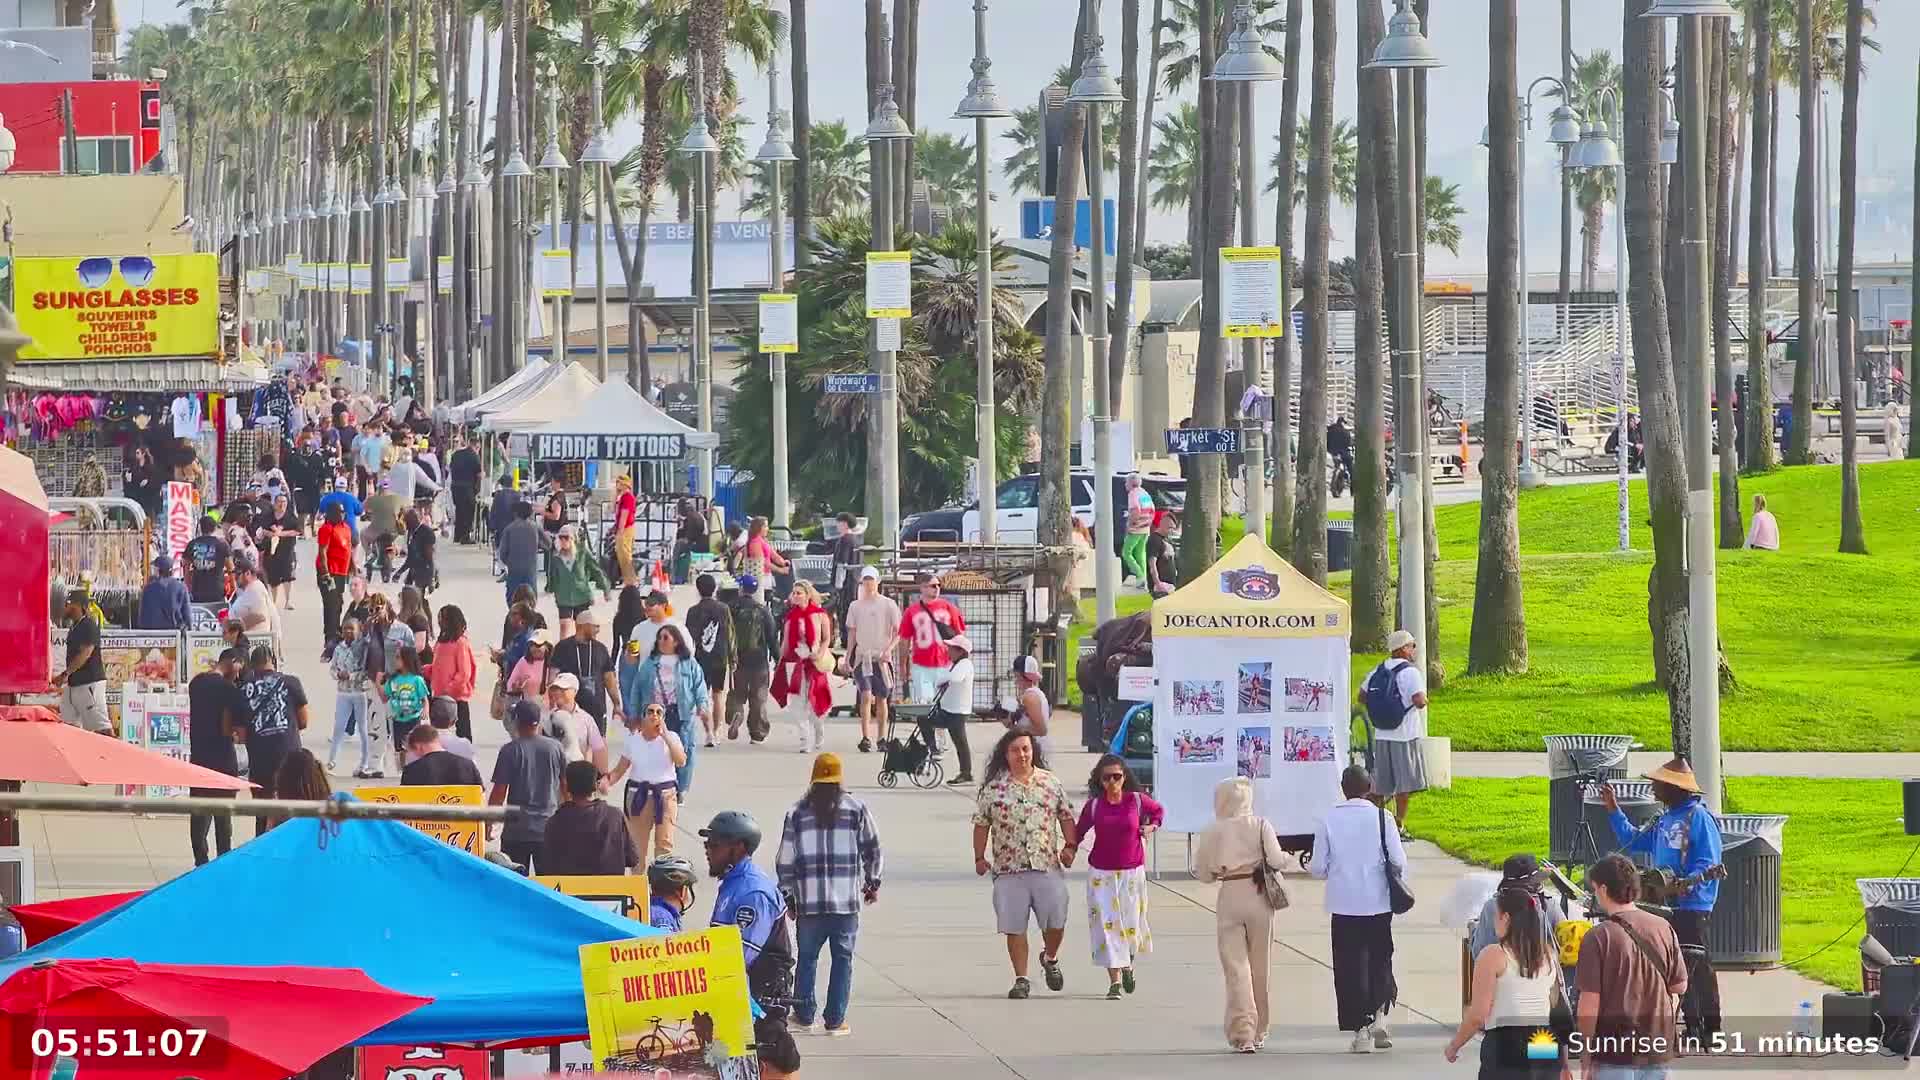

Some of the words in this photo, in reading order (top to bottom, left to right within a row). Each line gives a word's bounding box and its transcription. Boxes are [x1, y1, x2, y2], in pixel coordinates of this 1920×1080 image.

[666, 223, 720, 240] BEAH
[32, 288, 199, 310] SUNGLASSES
[77, 310, 157, 322] SOUVENIRS
[89, 322, 145, 333] TOWELS
[78, 332, 157, 344] CHILDRENS
[84, 343, 152, 355] PONCHOS
[827, 376, 867, 385] Windward
[1170, 431, 1209, 444] Market
[1222, 430, 1235, 443] St
[539, 435, 598, 460] HENNA
[604, 435, 680, 460] TATTOOS
[1216, 443, 1227, 451] 00
[1230, 443, 1236, 451] E
[1164, 614, 1315, 629] JOECANTOR.COM
[103, 639, 139, 648] UNNEL
[610, 943, 660, 964] Venice
[665, 935, 710, 957] beach
[622, 974, 652, 1003] BIKE
[653, 967, 708, 1000] RENTALS
